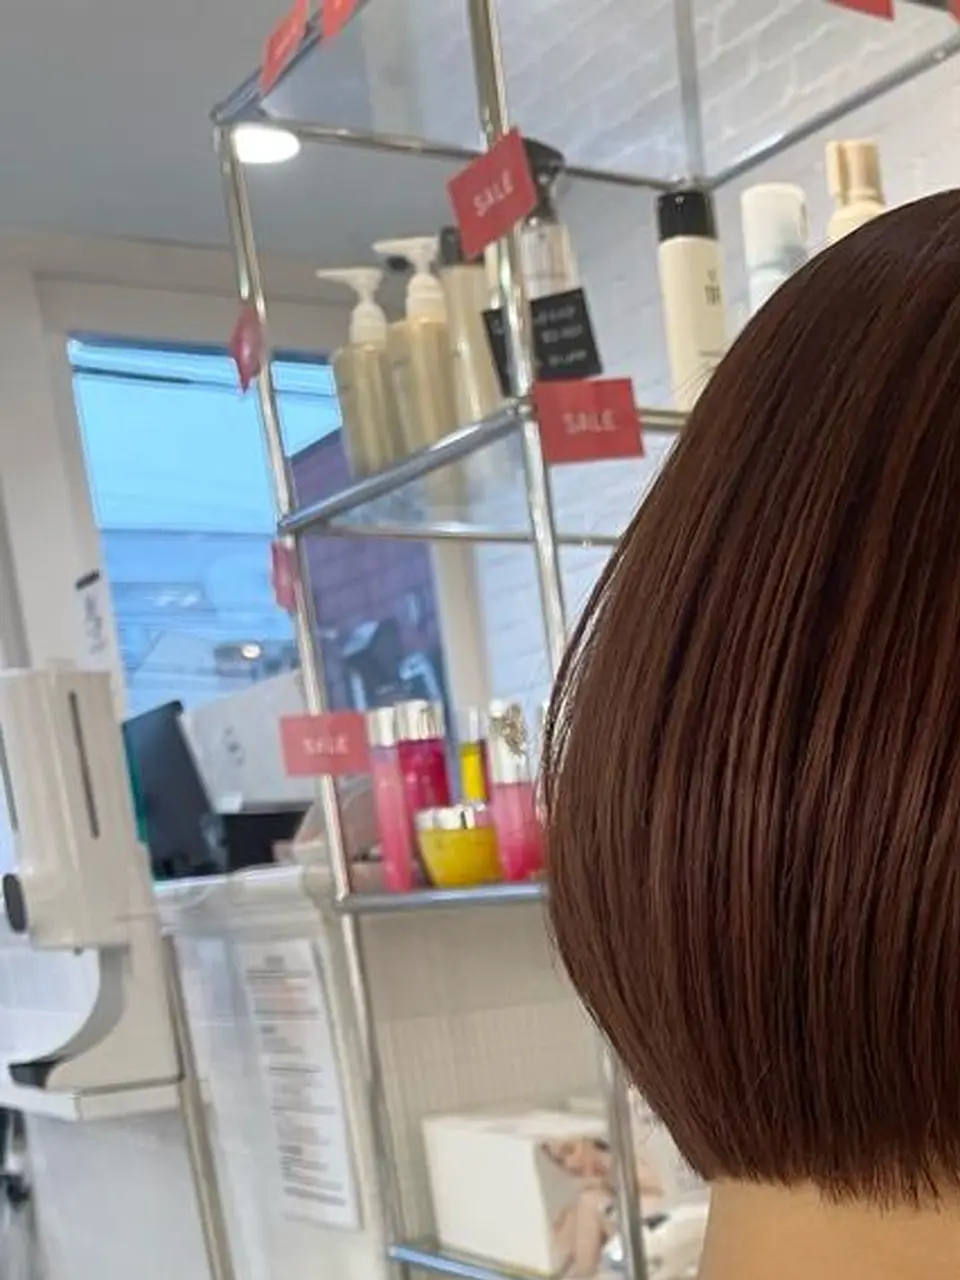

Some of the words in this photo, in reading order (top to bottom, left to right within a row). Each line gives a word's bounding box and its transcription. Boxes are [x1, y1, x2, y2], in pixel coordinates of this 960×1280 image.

[473, 168, 515, 217] SALE
[561, 409, 617, 435] SALE
[303, 735, 350, 755] SALE
